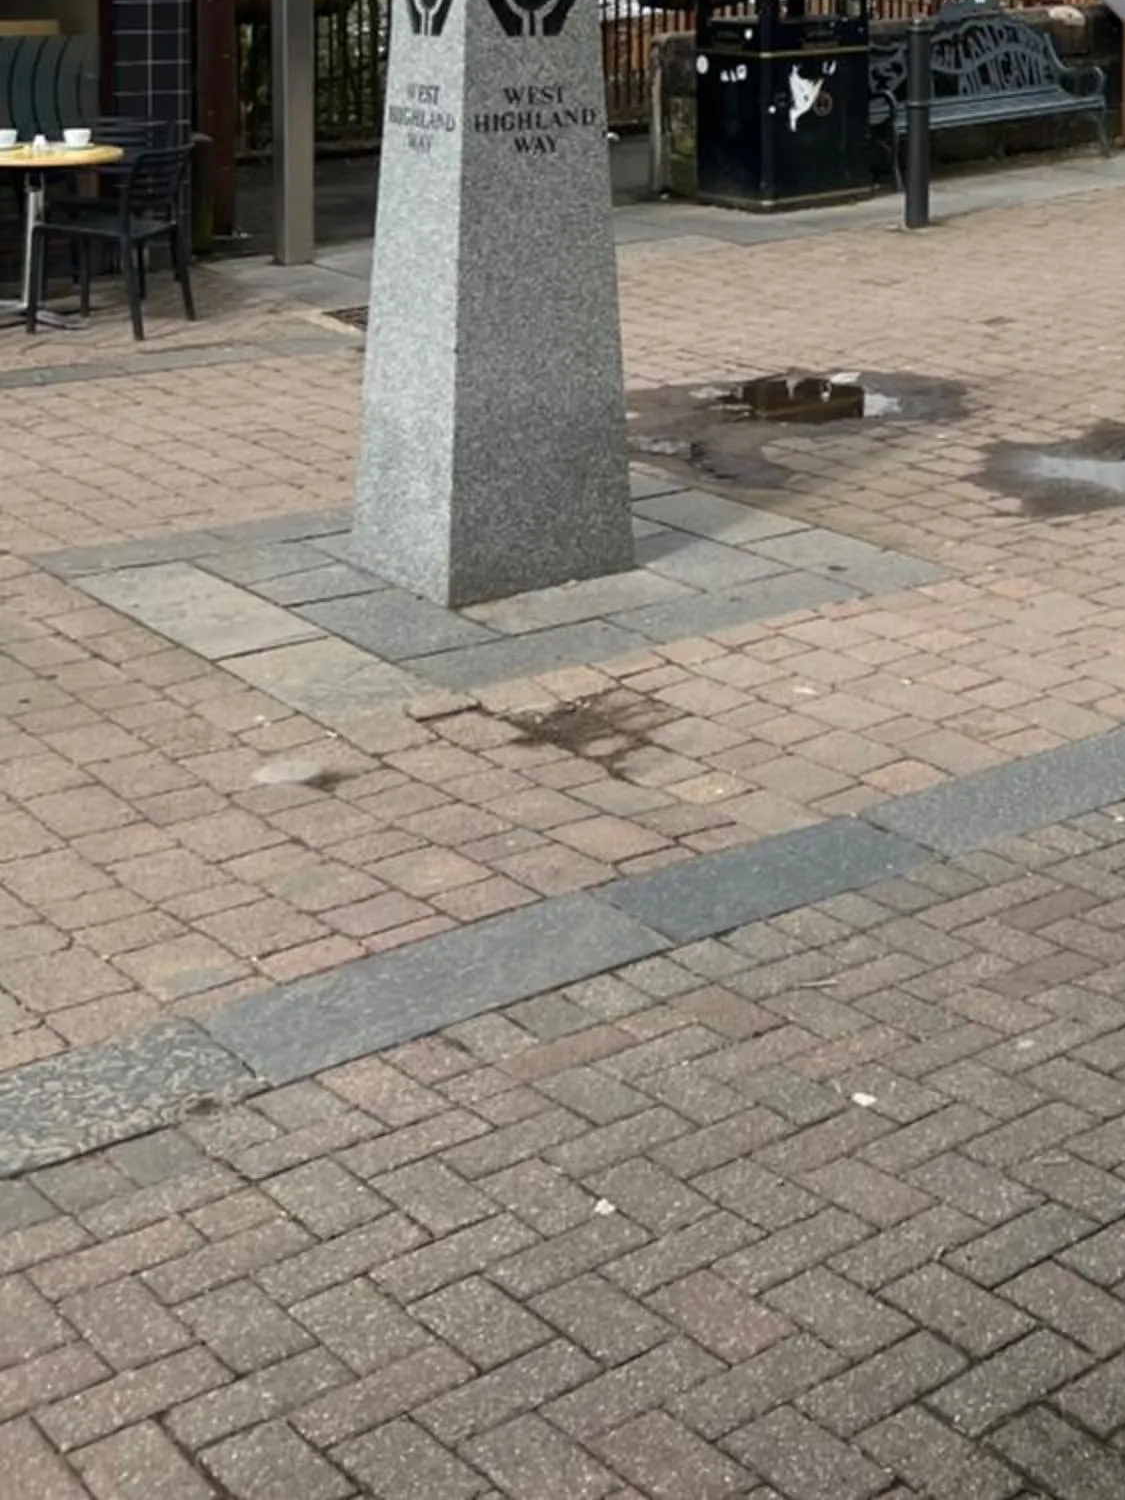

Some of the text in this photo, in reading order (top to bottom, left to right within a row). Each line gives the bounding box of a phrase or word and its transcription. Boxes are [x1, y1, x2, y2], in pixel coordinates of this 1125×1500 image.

[503, 85, 566, 105] WEST
[473, 107, 597, 133] HIGHLAND
[514, 135, 560, 154] WAY
